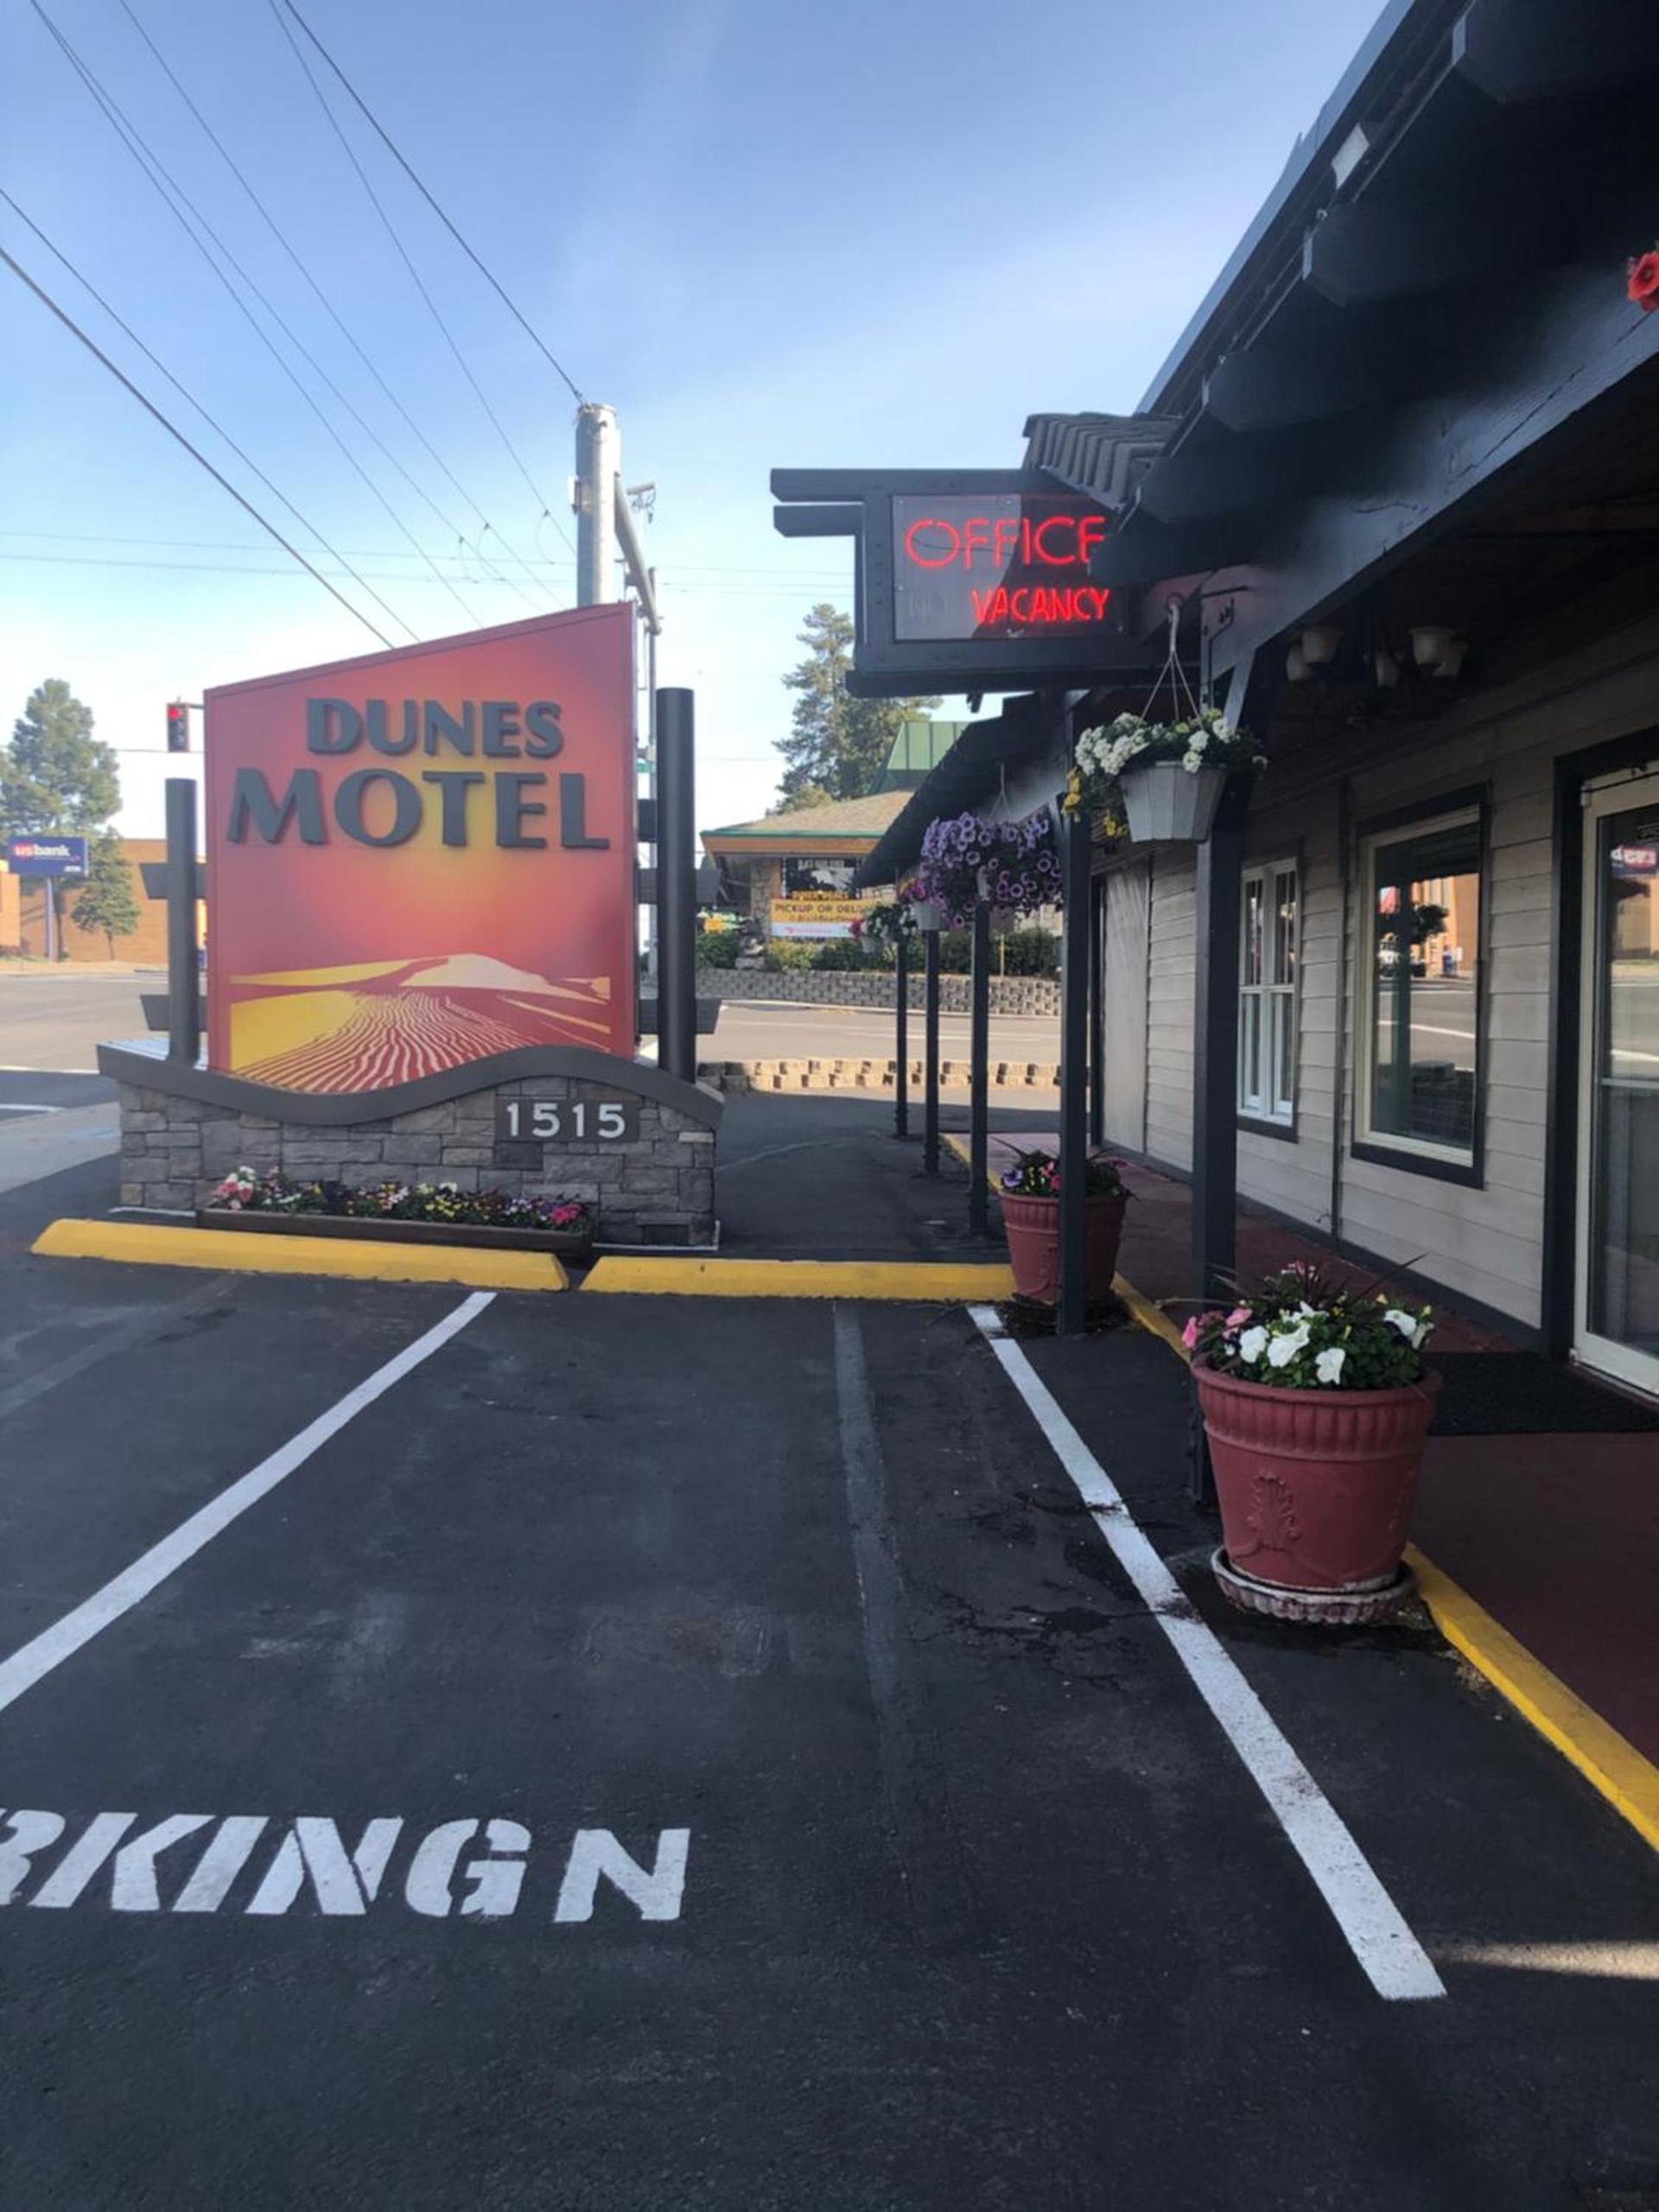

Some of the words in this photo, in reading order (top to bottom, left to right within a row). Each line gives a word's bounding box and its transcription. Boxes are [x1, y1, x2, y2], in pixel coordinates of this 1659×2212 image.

[904, 516, 1106, 569] OFFICE
[970, 588, 1110, 625] VACANCY
[306, 697, 565, 759] DUNES
[226, 767, 610, 849] MOTEL
[774, 904, 813, 912] PICKUP
[506, 1103, 626, 1138] 1515
